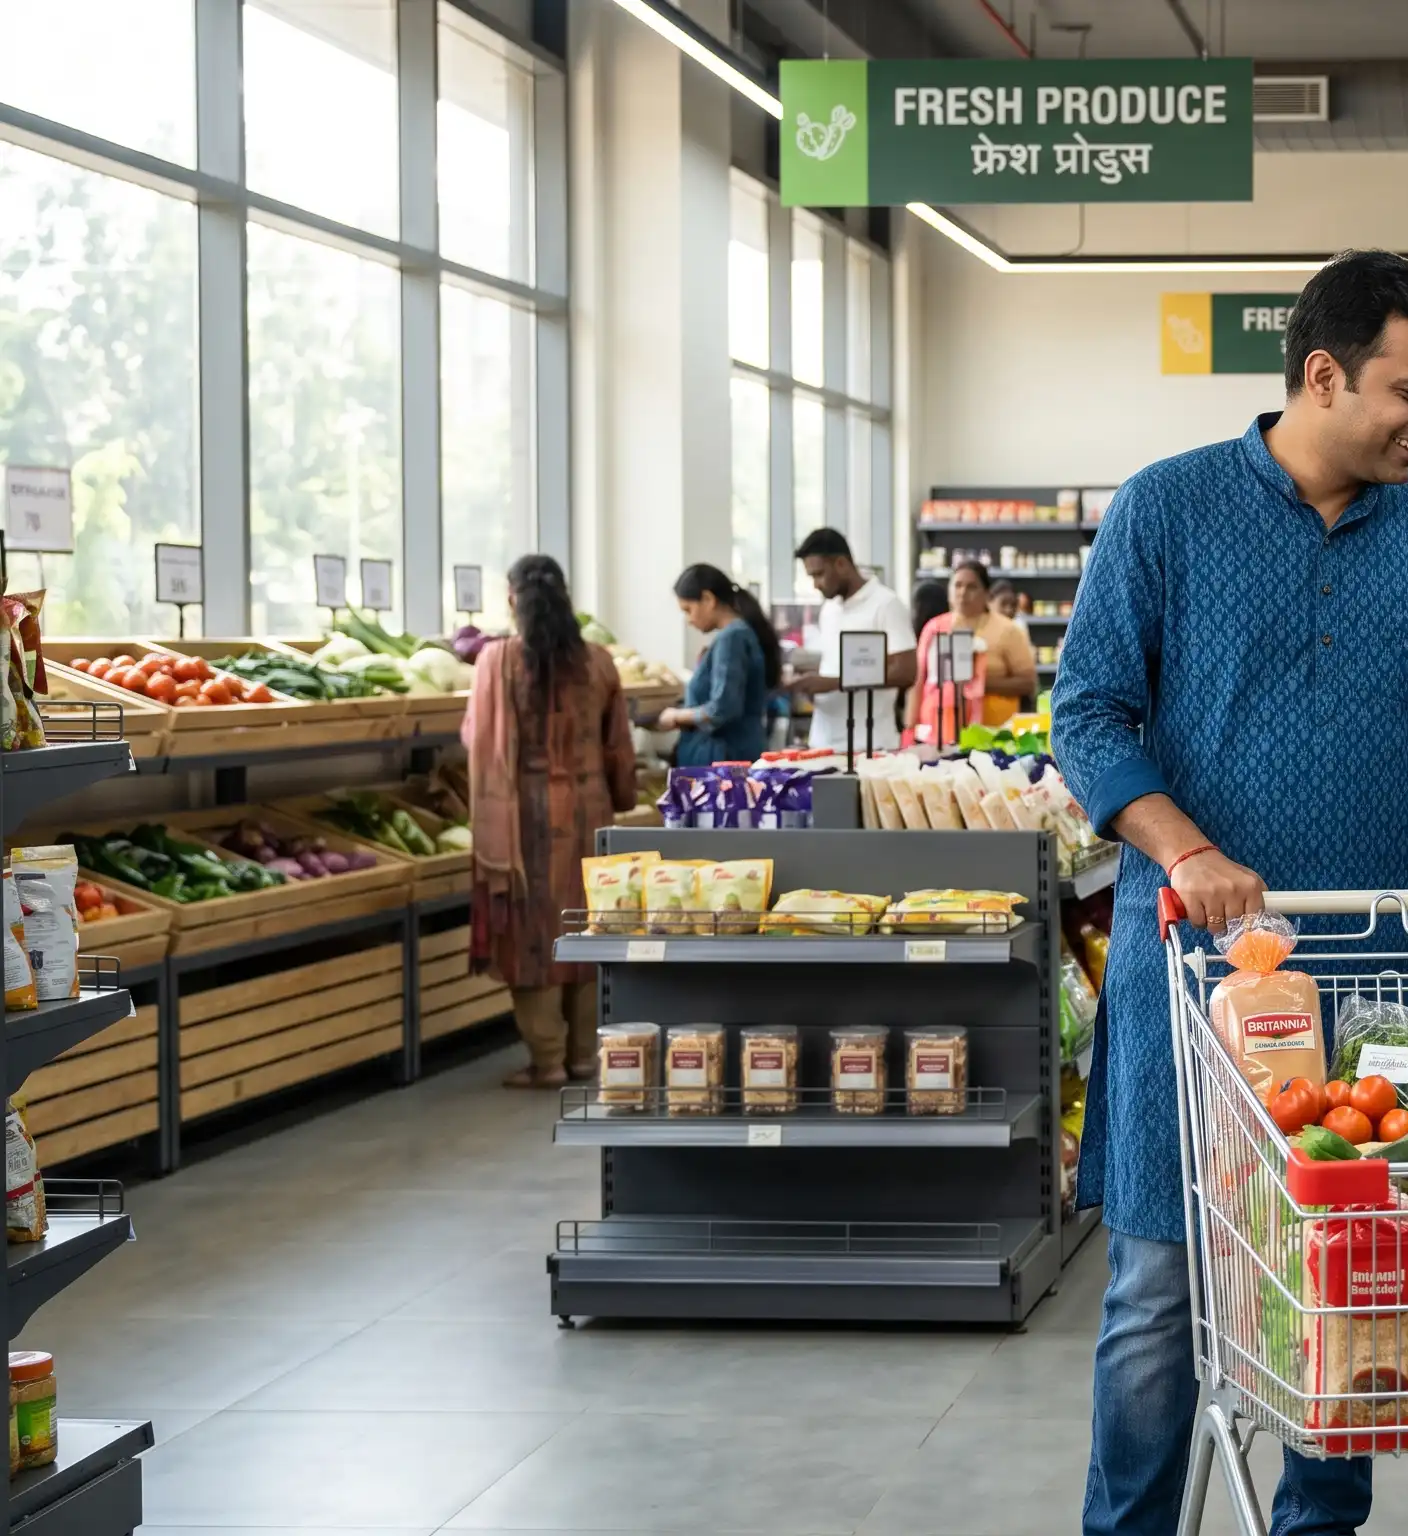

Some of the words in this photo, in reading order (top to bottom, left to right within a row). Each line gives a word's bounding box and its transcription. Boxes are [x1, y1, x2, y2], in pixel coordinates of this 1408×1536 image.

[895, 86, 1023, 125] FRESH
[1037, 85, 1227, 125] PRODUCE
[971, 132, 1042, 175] फ्रेश
[1247, 1018, 1309, 1033] BRITANNIA
